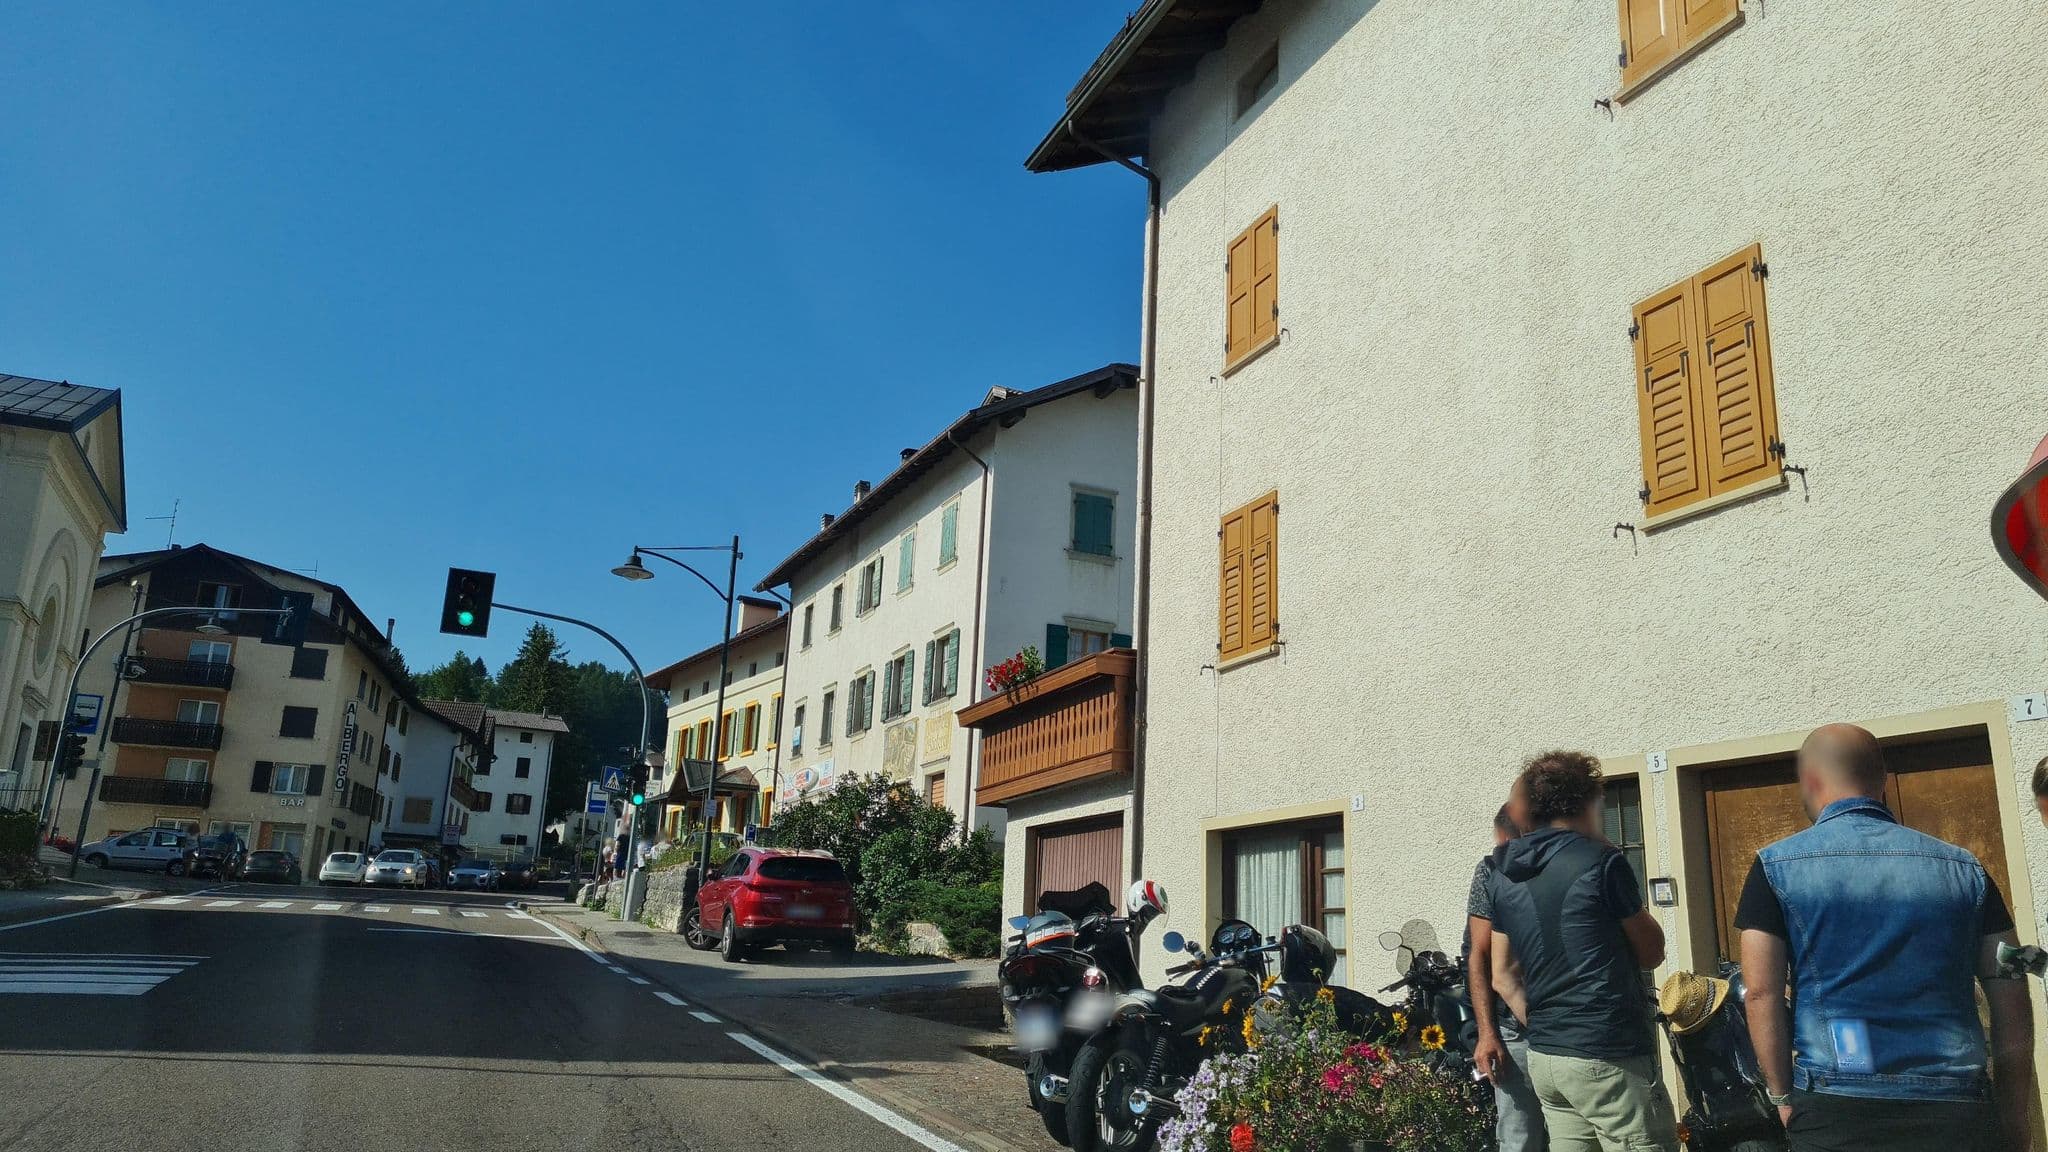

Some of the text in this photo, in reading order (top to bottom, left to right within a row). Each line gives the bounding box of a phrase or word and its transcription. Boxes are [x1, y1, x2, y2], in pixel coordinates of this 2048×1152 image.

[2024, 698, 2033, 715] 7
[336, 703, 355, 789] ALBERGO
[1654, 755, 1659, 768] 5
[280, 798, 305, 806] BAR
